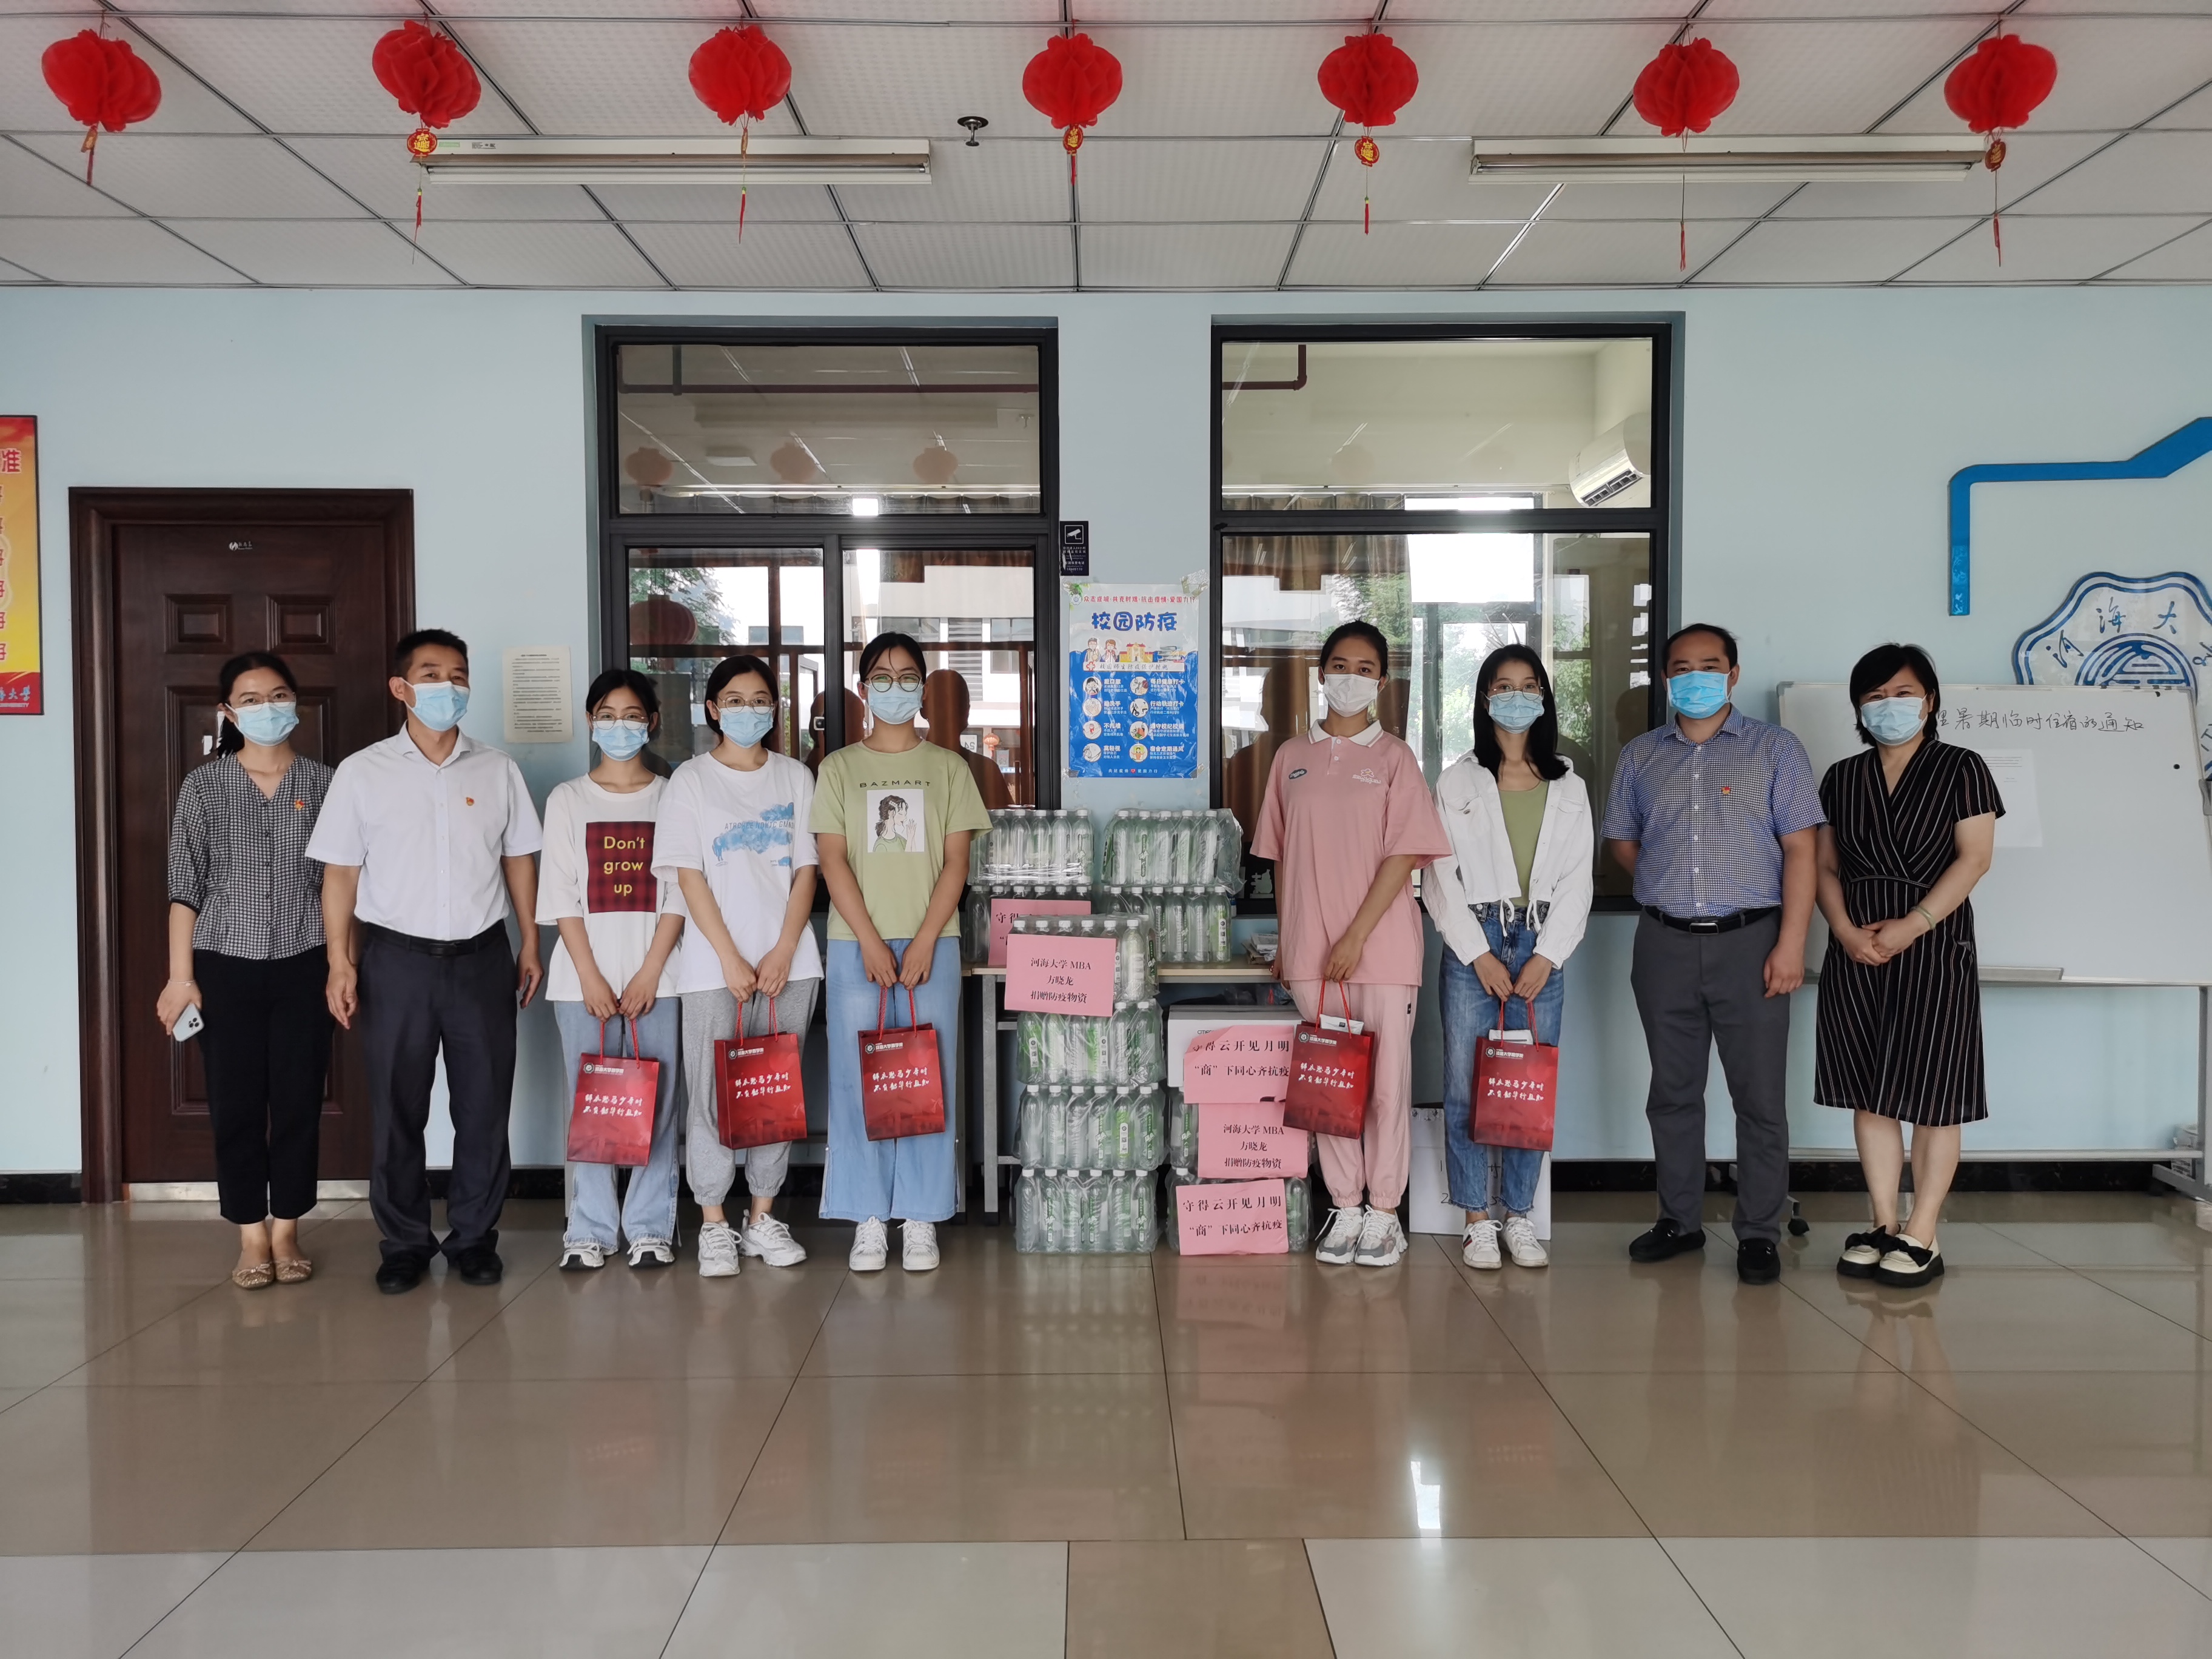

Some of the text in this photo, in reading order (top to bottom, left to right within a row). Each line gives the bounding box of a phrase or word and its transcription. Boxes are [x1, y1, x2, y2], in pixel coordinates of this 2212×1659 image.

[1091, 611, 1178, 631] 校园防疫
[604, 836, 645, 850] Don't
[604, 861, 644, 874] grow
[614, 884, 632, 897] up
[1031, 957, 1091, 970] 河海大学 MBA
[1047, 975, 1074, 986] 方晓龙
[1031, 990, 1087, 1004] 捐赠防疫物资
[1223, 1124, 1284, 1135] 河海大学 MBA
[1240, 1141, 1267, 1151] 方晓龙
[1224, 1157, 1282, 1170] 捐赠防疫物资
[1183, 1196, 1281, 1212] 守得云开见月明
